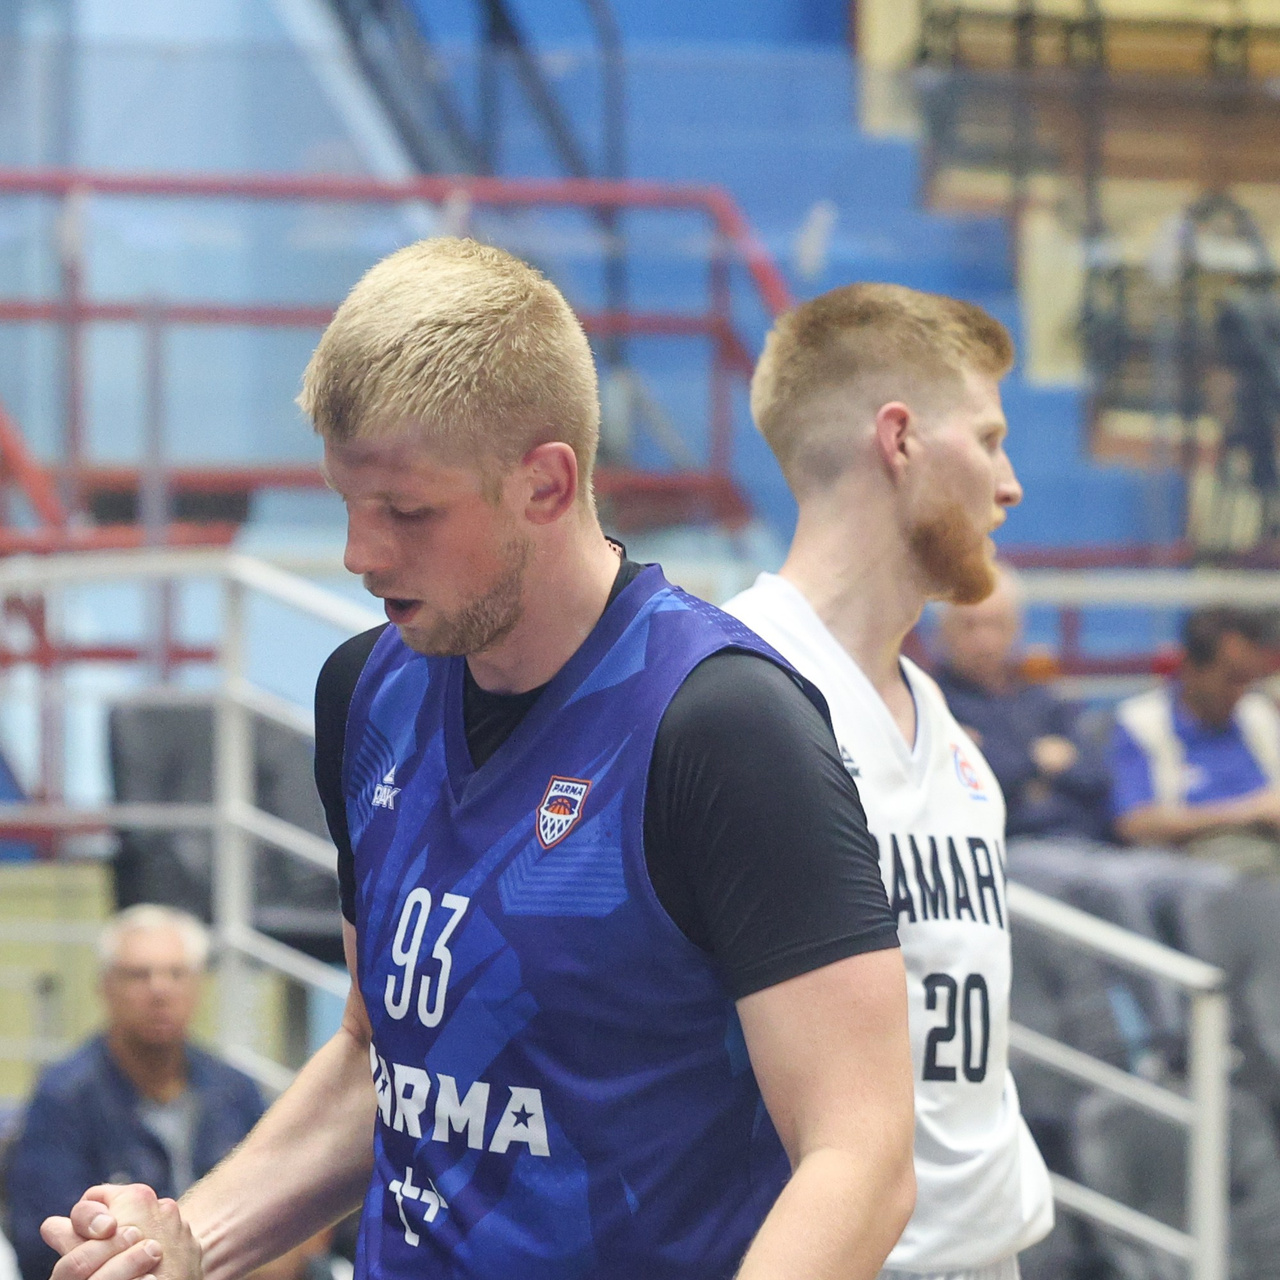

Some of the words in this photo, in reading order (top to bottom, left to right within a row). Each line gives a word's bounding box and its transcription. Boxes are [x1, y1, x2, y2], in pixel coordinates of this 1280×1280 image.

[552, 783, 583, 796] PARMA
[870, 832, 1006, 931] AMAR
[384, 887, 470, 1028] 93
[922, 973, 990, 1083] 20
